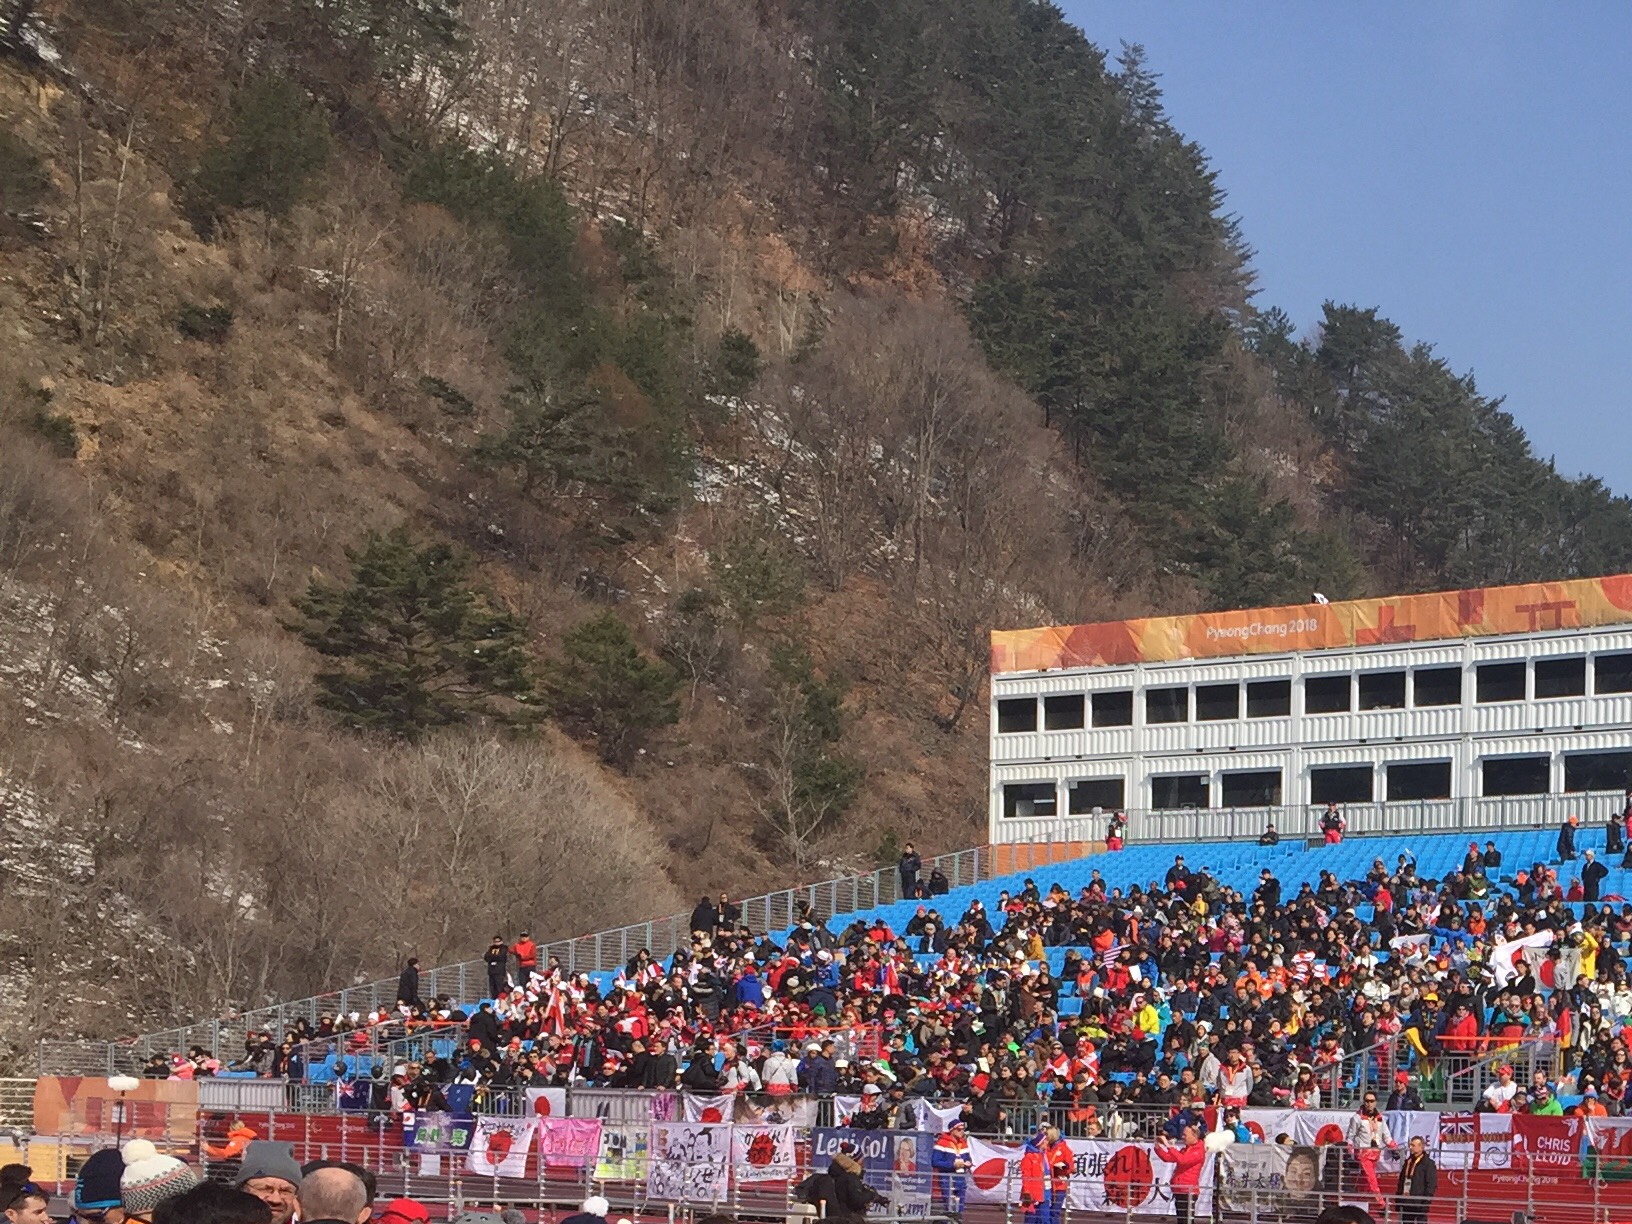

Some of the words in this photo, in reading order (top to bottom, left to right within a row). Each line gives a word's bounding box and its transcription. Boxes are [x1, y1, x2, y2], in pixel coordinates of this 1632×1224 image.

[1206, 622, 1288, 642] PyeongChang
[1289, 618, 1318, 634] 2018
[1537, 1136, 1571, 1152] CHRIS
[1535, 1152, 1571, 1166] LLOYD
